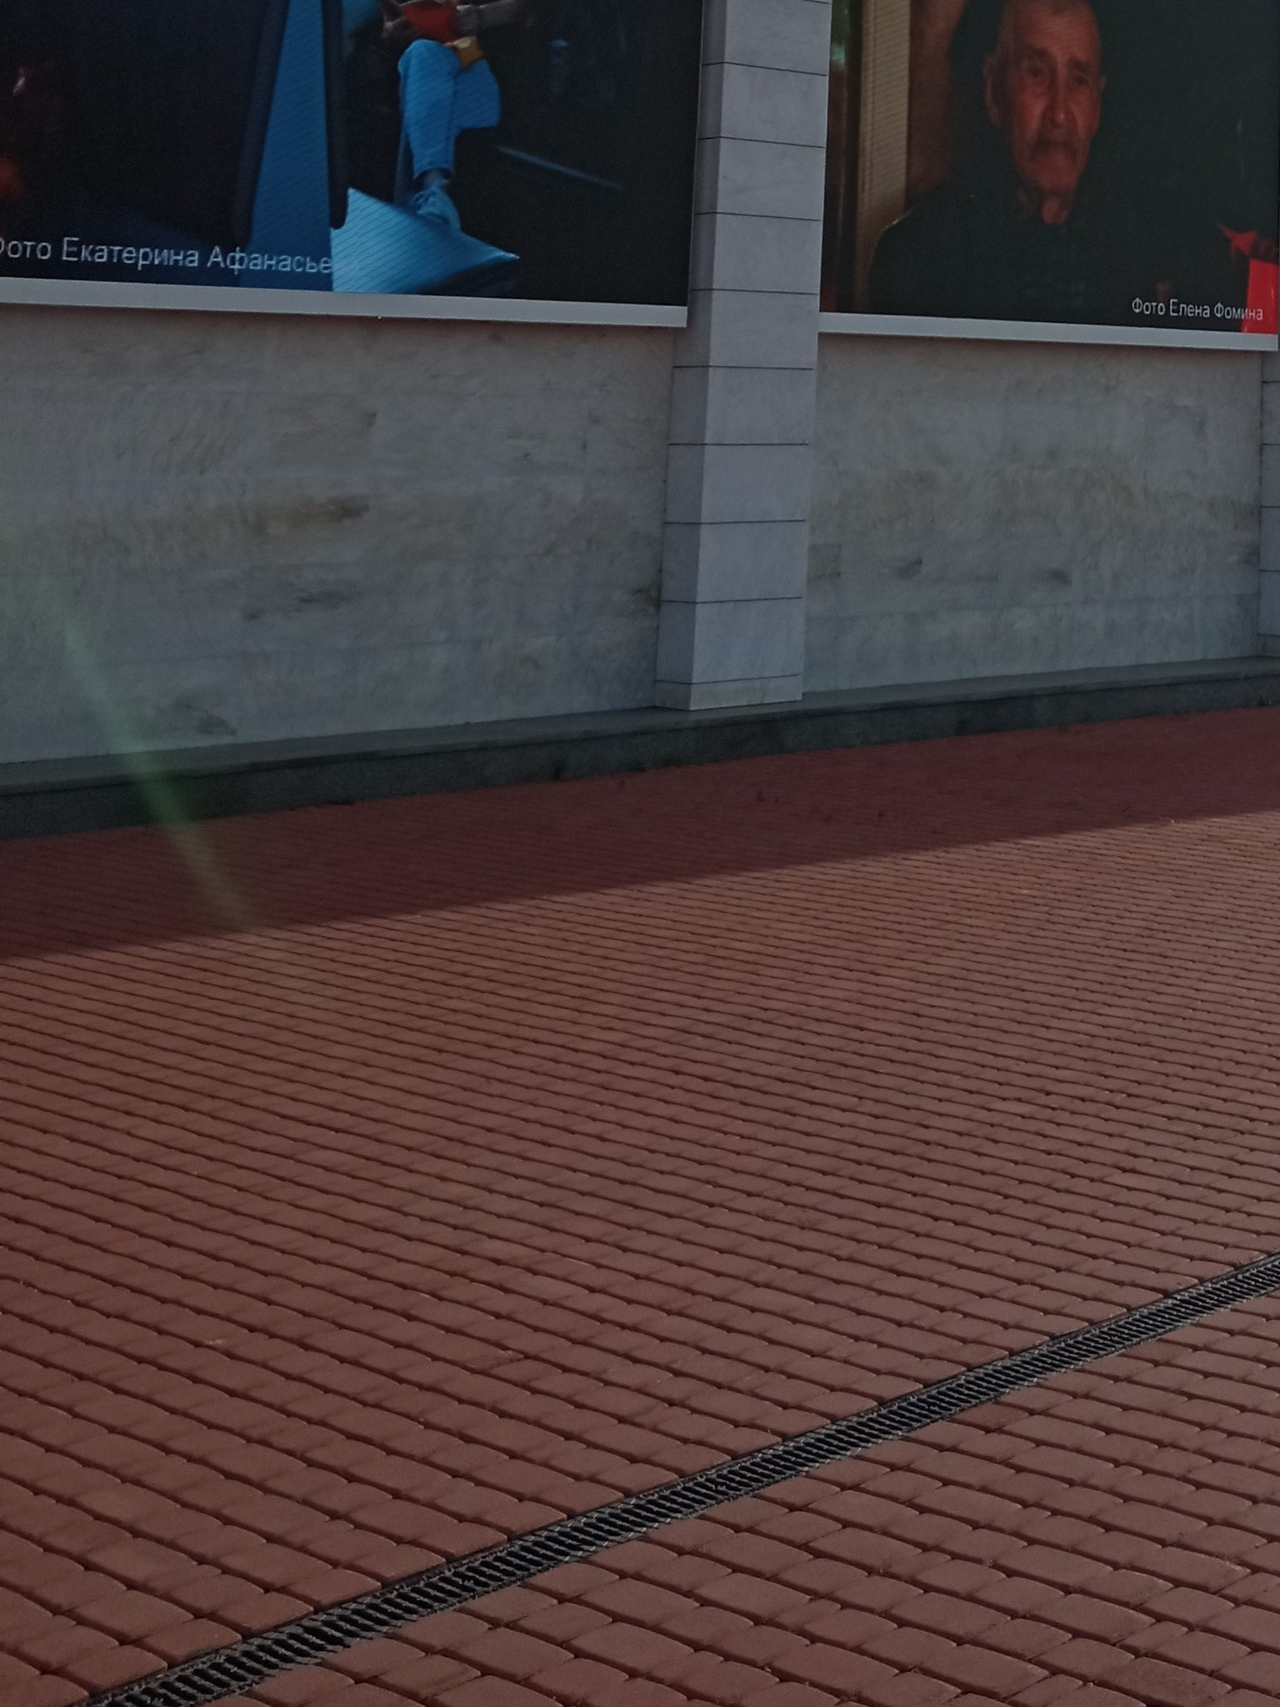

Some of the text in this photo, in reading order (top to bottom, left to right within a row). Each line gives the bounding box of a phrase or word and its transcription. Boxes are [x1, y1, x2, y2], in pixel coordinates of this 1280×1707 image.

[0, 237, 52, 260] ото
[62, 236, 199, 271] Екатерина
[1131, 297, 1264, 321] Фото Елена Фомина
